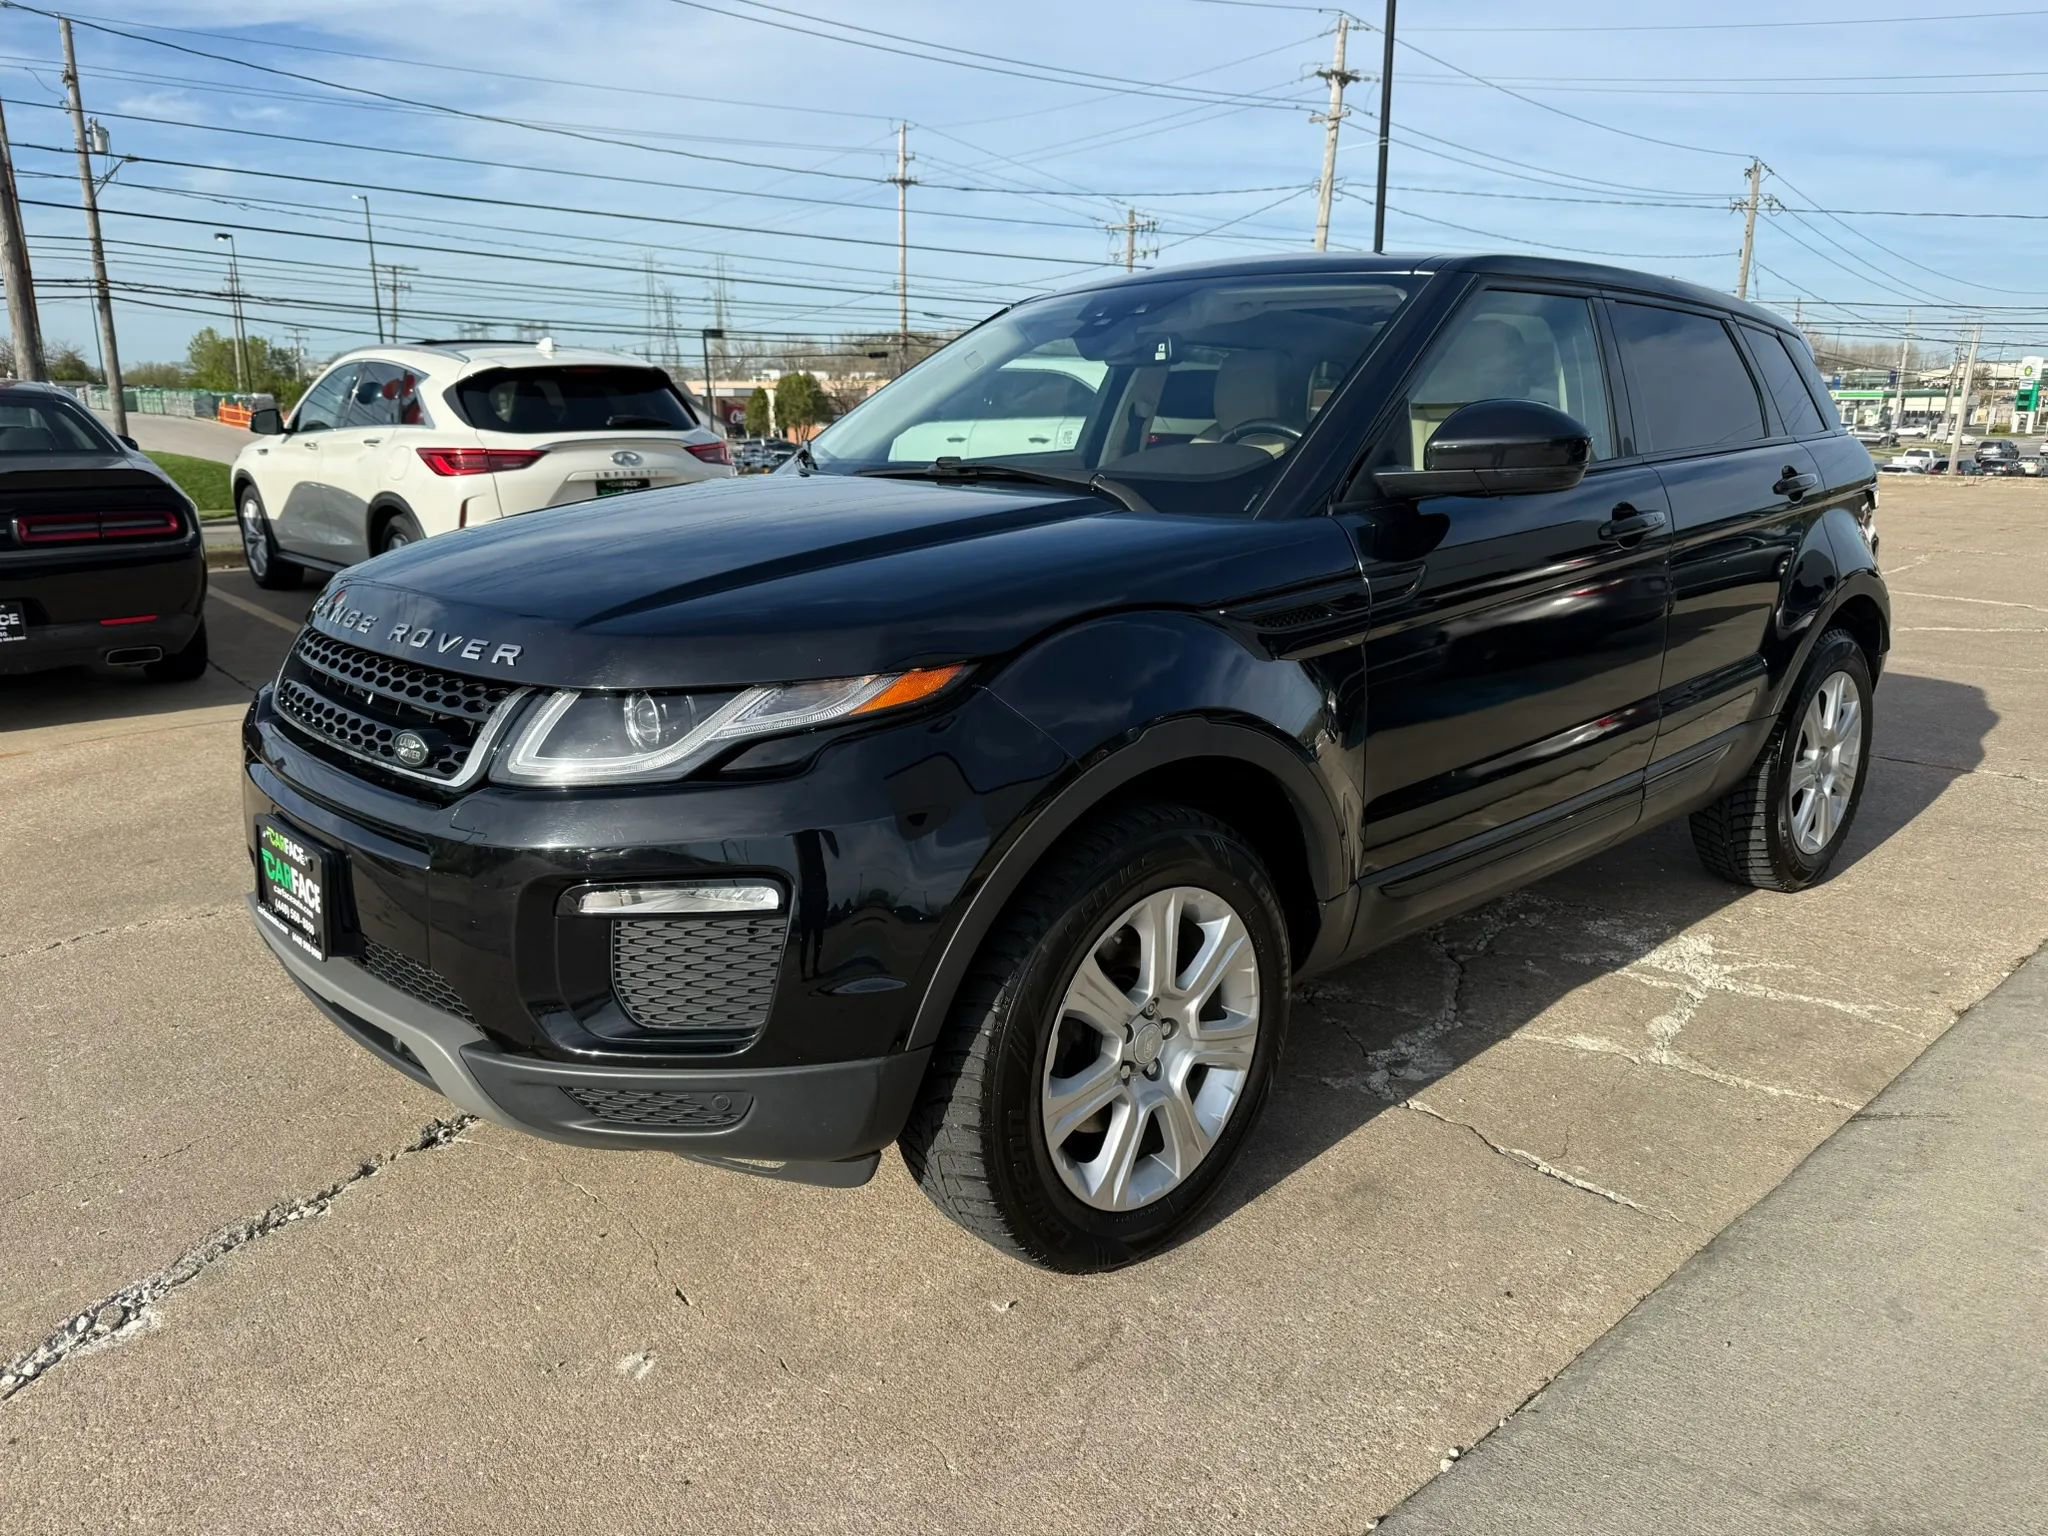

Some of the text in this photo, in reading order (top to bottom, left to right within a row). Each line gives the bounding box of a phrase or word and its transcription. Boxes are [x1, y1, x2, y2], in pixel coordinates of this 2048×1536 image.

[312, 597, 524, 666] RANGE ROVER
[399, 736, 416, 749] LAND
[399, 747, 421, 760] ROVER
[265, 826, 306, 866] CARFACE
[261, 847, 321, 914] CARFACE
